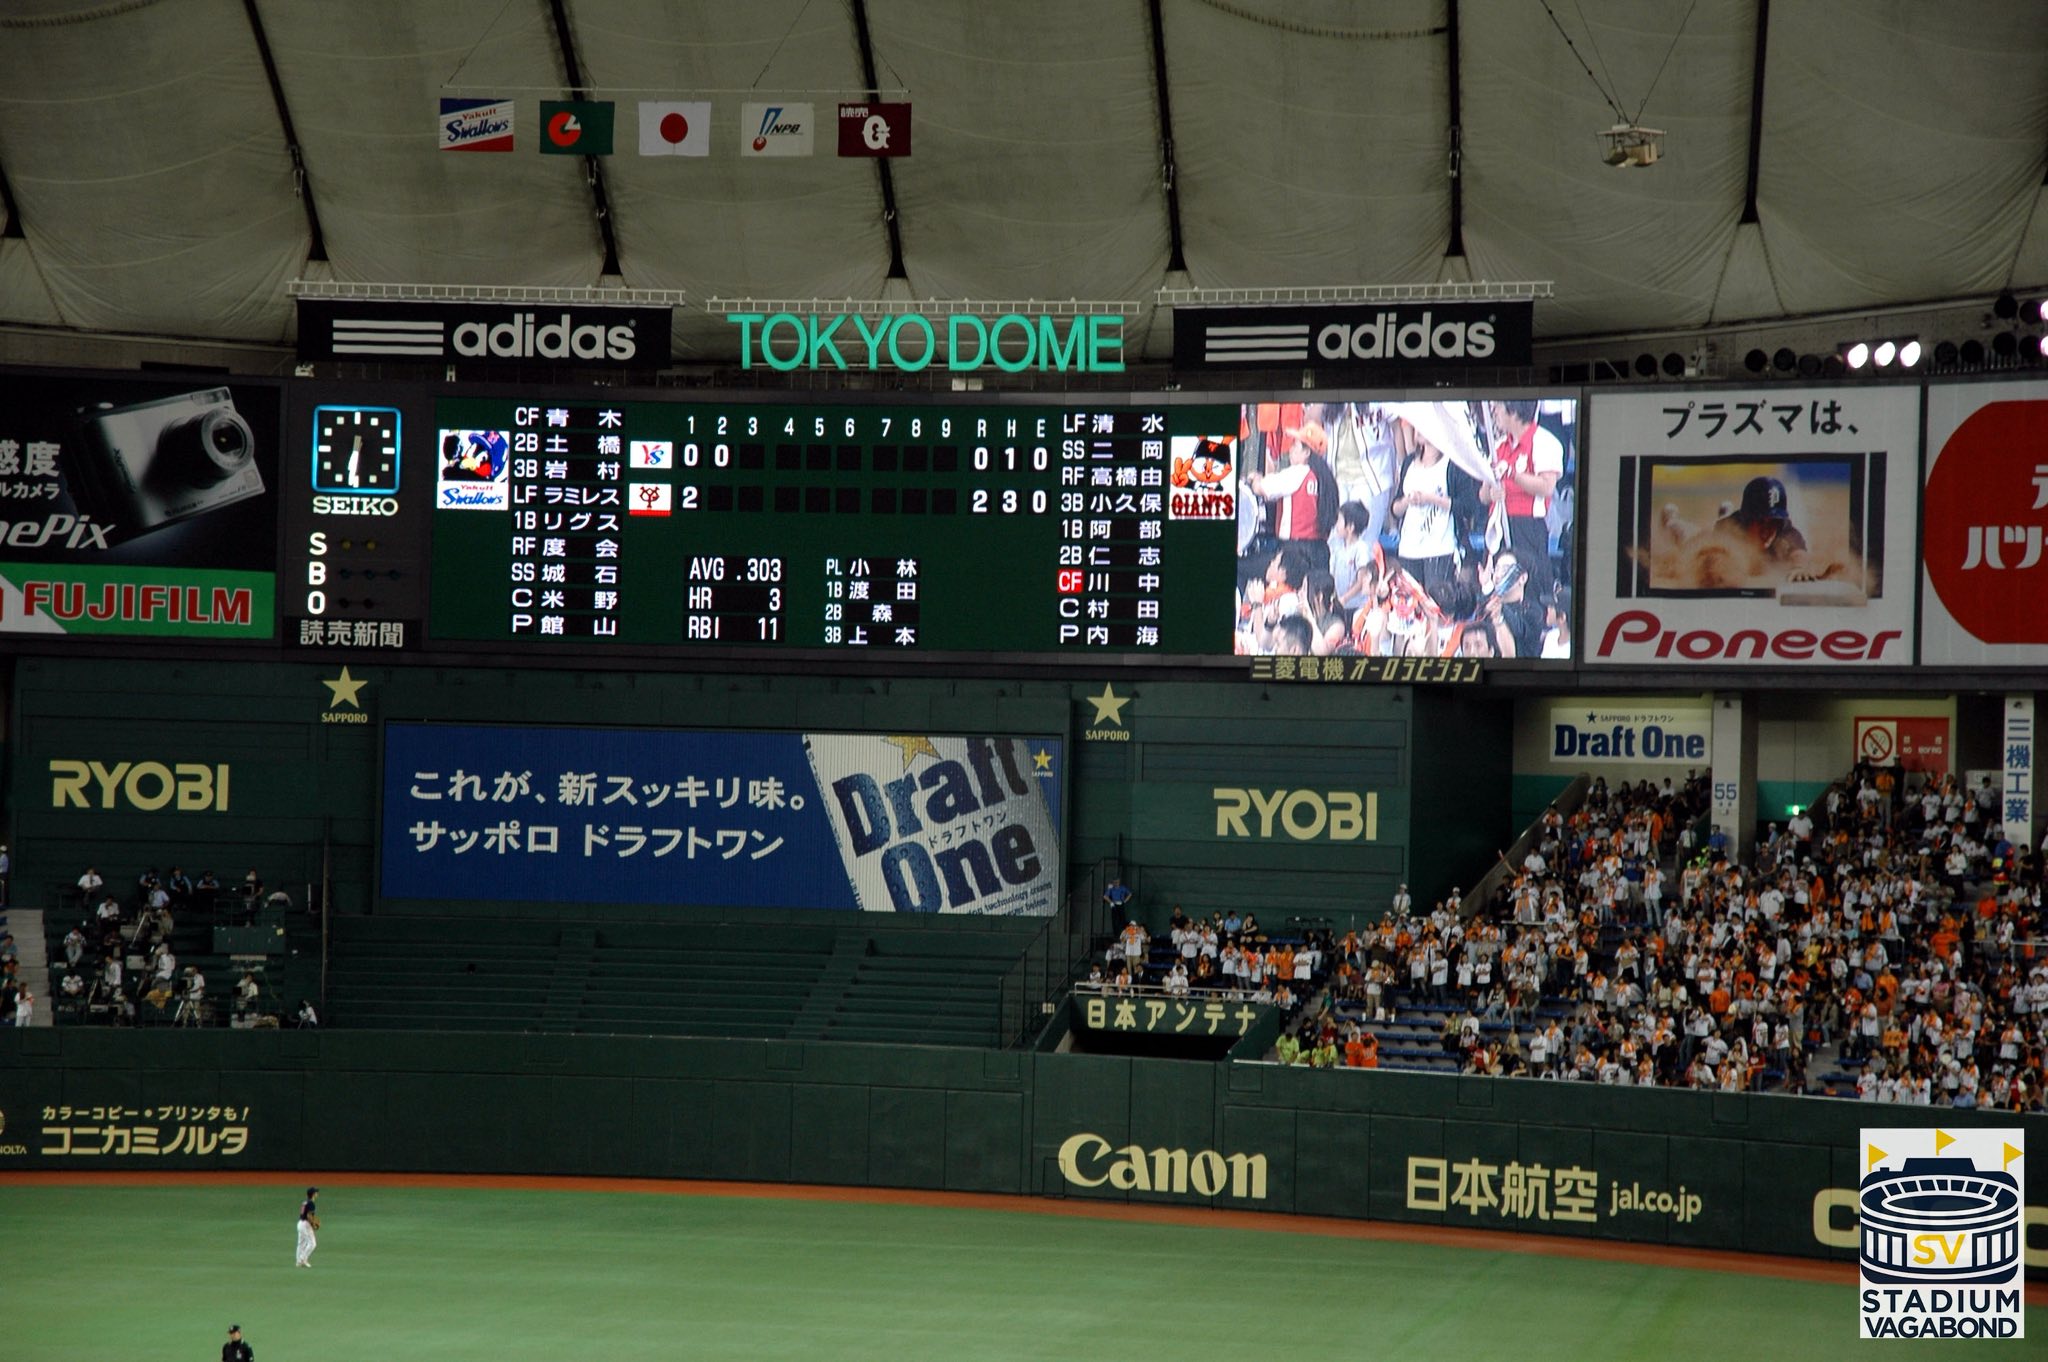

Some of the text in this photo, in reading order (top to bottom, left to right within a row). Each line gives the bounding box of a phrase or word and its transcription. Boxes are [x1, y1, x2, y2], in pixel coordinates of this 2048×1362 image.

[462, 108, 496, 120] Yakult
[446, 119, 509, 142] Swallows
[772, 124, 801, 134] NPB
[453, 314, 636, 360] adidas
[727, 313, 1124, 373] TOKYO DOME
[1317, 311, 1496, 359] adidas
[515, 407, 539, 425] CF
[687, 416, 1046, 438] 1 2 3 4 5 6 7 8 9 R H E
[1063, 414, 1086, 433] LF
[1662, 400, 1859, 439] プラズマは、
[514, 433, 538, 452] 2B
[1062, 440, 1085, 460] SS
[684, 443, 698, 466] 0
[714, 444, 729, 467] 0
[974, 447, 988, 470] 0
[1004, 447, 1015, 470] 1
[1033, 447, 1048, 470] 0
[514, 459, 538, 478] 3B
[1062, 466, 1162, 487] RF 高橋由
[313, 497, 399, 516] SEIKO
[442, 488, 503, 506] Swallows
[514, 485, 620, 506] LF ラミレス
[682, 486, 698, 508] 2
[972, 490, 988, 513] 2
[1002, 490, 1017, 513] 3
[1032, 490, 1047, 513] 0
[1061, 493, 1163, 513] 3B 小久保
[1171, 493, 1234, 517] GIANTS
[514, 511, 619, 531] 1B リグス
[1062, 519, 1083, 539] 1B
[309, 532, 327, 556] S
[512, 537, 536, 555] RF
[1059, 545, 1082, 565] 2B
[308, 561, 326, 586] B
[511, 563, 535, 582] SS
[689, 557, 782, 582] AVG .303
[826, 558, 843, 576] PL
[827, 581, 843, 598] 1B
[1059, 572, 1082, 591] CF
[23, 581, 252, 626] FUJIFILM
[512, 588, 532, 607] C
[689, 586, 780, 611] HR 3
[1059, 598, 1079, 618] C
[512, 614, 532, 633] P
[825, 603, 892, 623] 2B 森
[300, 619, 404, 648] 読売新聞
[688, 616, 778, 640] RBI 11
[825, 626, 841, 644] 3B
[1060, 624, 1079, 644] P
[1597, 610, 1902, 661] Pioneer
[1252, 656, 1480, 682] 三菱電機 オーロラビジョン
[322, 713, 368, 724] SAPPORO
[1085, 730, 1130, 741] SAPPORO
[1555, 724, 1705, 759] Draft One
[2005, 718, 2031, 824] 三機工業
[50, 760, 229, 812] RYOBI
[410, 770, 805, 810] これが、新スッキリ味。
[1714, 783, 1737, 800] 55
[832, 737, 1029, 858] Draft
[1213, 788, 1378, 841] RYOBI
[409, 820, 784, 860] サッポロ ドラフトワン
[928, 811, 1007, 849] ドラフトワン
[881, 824, 1041, 914] One
[1088, 999, 1256, 1036] 日本アンテナ
[41, 1125, 248, 1155] コニカミノルタ
[1058, 1133, 1267, 1199] Canon
[1407, 1156, 1702, 1223] 日本航空 jal.co.jp
